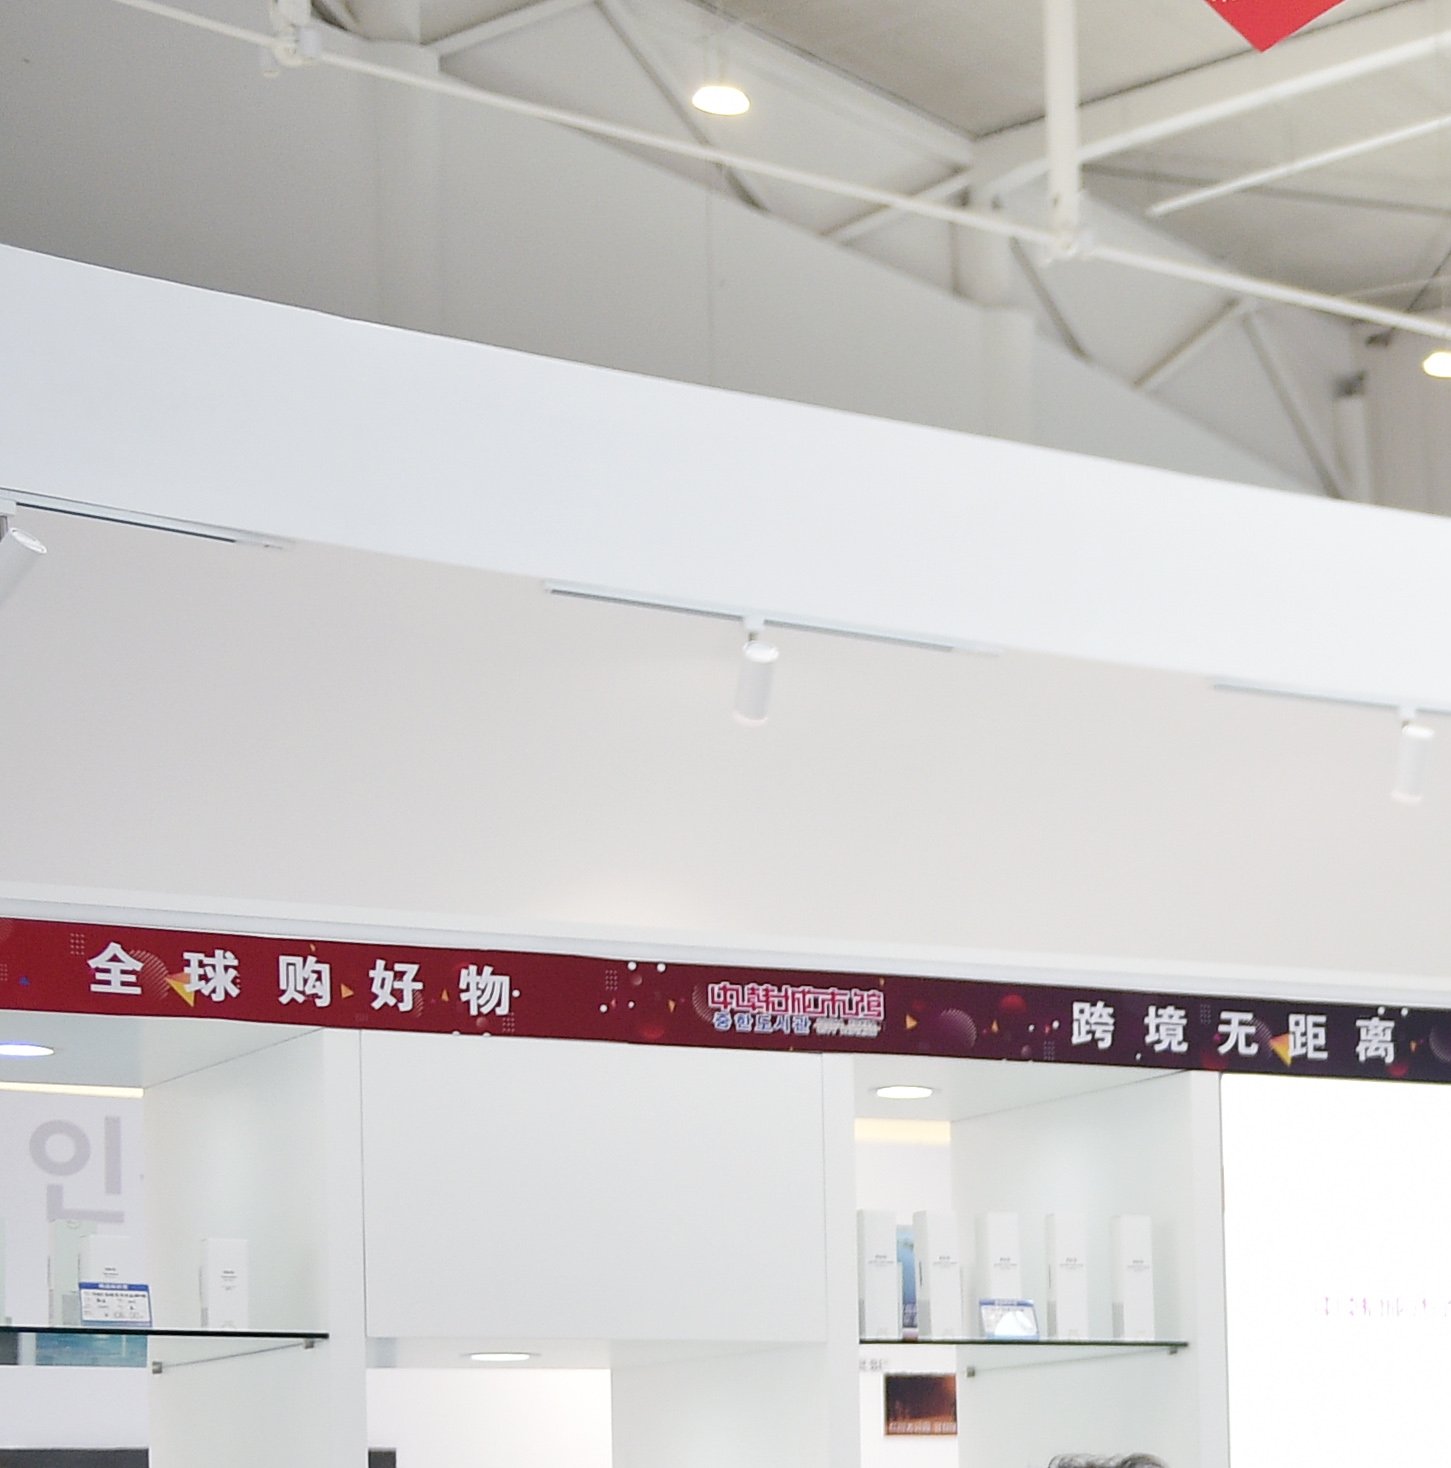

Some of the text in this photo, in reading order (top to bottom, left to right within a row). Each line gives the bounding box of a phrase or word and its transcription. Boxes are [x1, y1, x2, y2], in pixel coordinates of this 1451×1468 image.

[87, 941, 511, 1016] 全球购好物
[712, 1011, 811, 1035] 중한도시관
[1071, 1001, 1396, 1064] 跨境无距离
